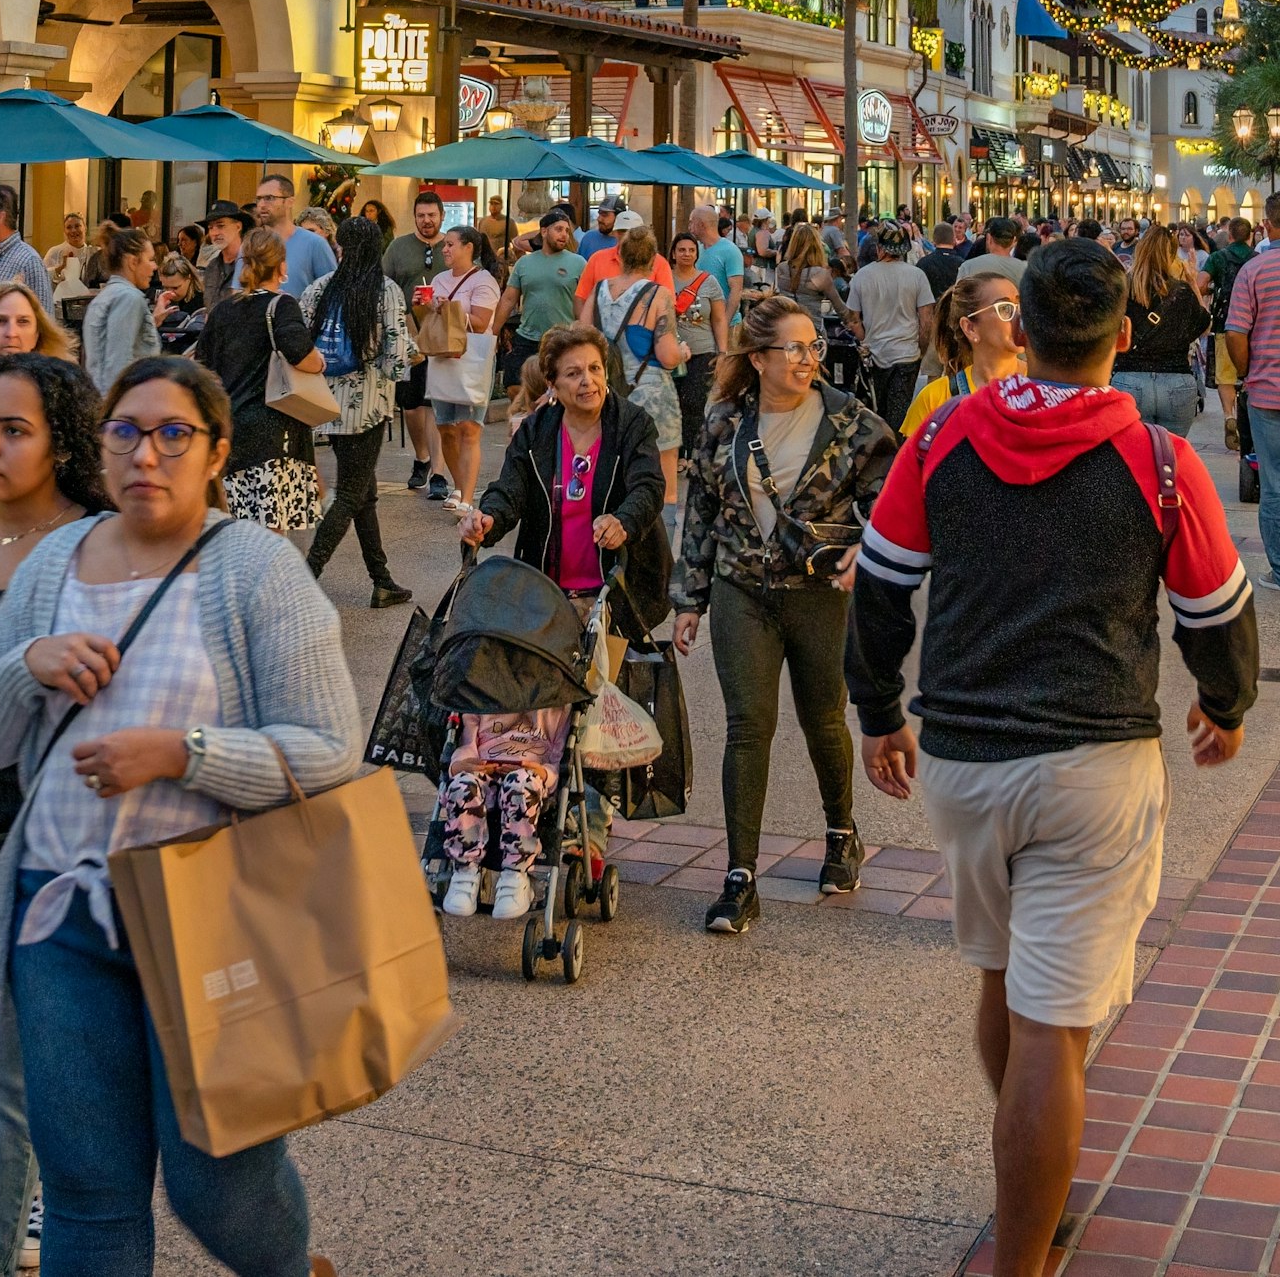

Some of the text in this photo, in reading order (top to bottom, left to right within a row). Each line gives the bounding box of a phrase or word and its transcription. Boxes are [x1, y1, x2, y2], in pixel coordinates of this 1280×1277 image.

[383, 13, 408, 29] The
[361, 28, 430, 60] POLITE
[360, 59, 429, 82] PIG
[924, 117, 955, 127] ON JON
[372, 744, 426, 767] FABL
